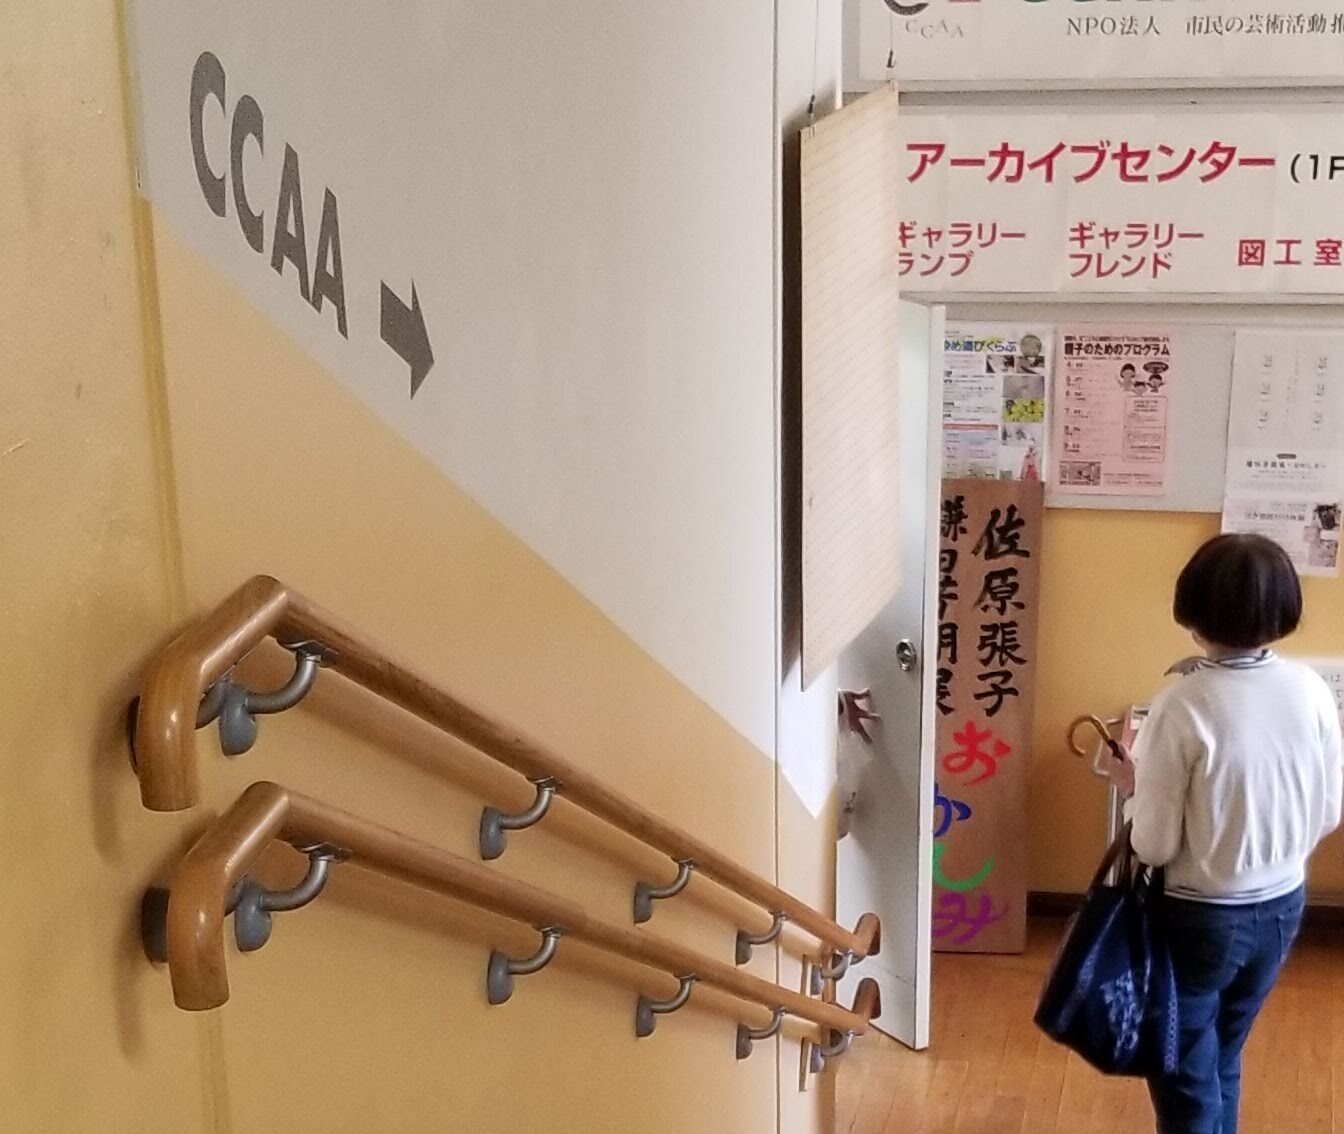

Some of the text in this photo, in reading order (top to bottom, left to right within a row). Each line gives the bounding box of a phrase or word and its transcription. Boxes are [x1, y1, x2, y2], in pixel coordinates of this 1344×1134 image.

[1066, 16, 1160, 36] NPO法人
[906, 139, 1276, 184] アーカイブセンター
[189, 51, 349, 340] CCAA
[1068, 220, 1205, 250] ギャラリー
[1068, 251, 1173, 280] フレンド
[971, 503, 1030, 717] 佐原張子
